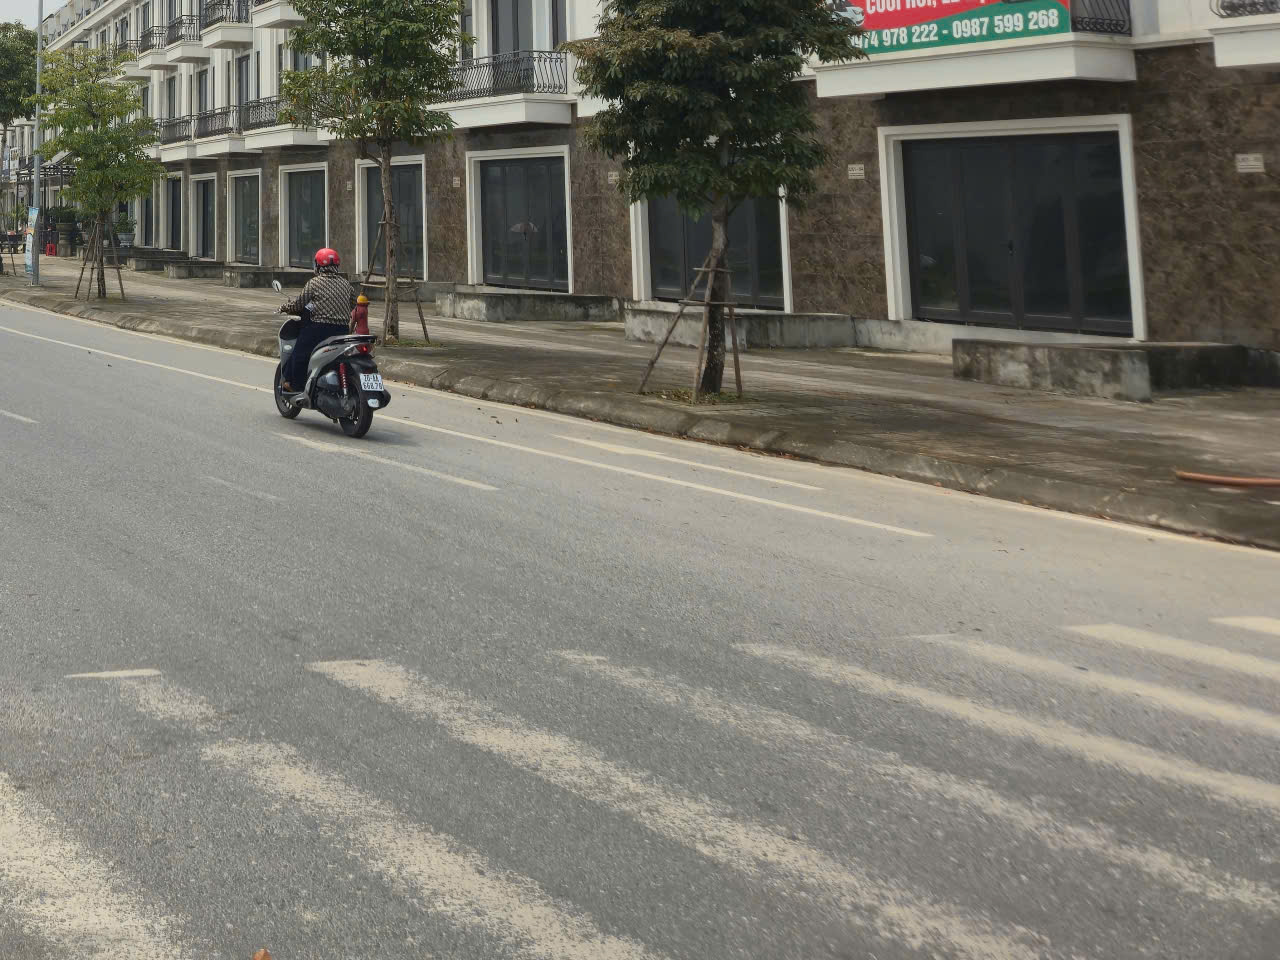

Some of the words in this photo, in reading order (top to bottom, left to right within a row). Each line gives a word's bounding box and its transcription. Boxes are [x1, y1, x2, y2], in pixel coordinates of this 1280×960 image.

[883, 27, 908, 46] 978
[911, 23, 938, 43] 222
[952, 17, 989, 39] 0987
[994, 13, 1024, 34] 599
[1028, 8, 1059, 30] 268
